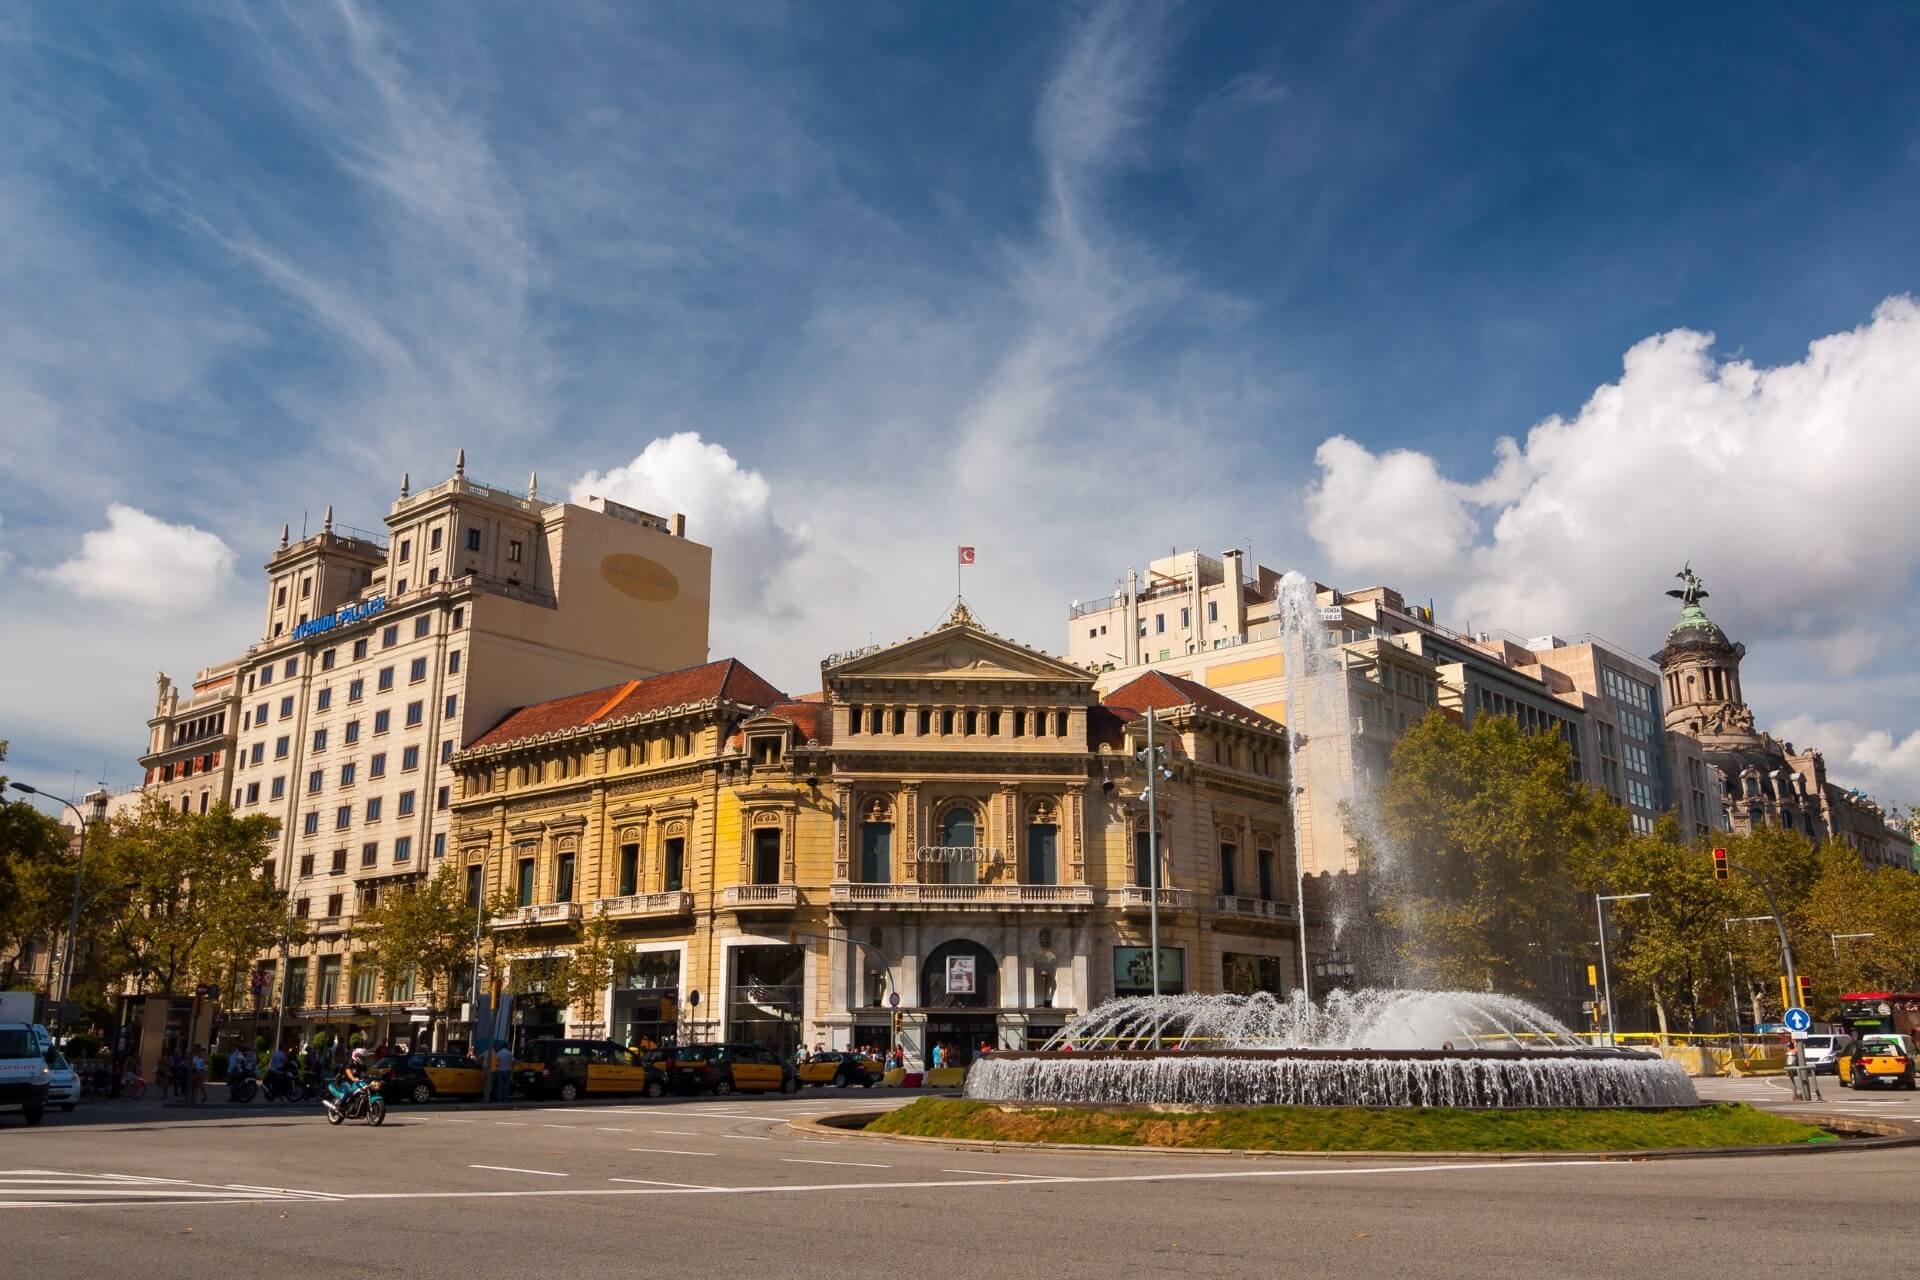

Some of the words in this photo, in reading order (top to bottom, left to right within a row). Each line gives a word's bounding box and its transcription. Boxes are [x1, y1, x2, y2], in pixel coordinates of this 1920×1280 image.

[292, 613, 336, 640] AVENIDA
[340, 596, 385, 625] PALACE
[917, 846, 1004, 863] COMEDIA
